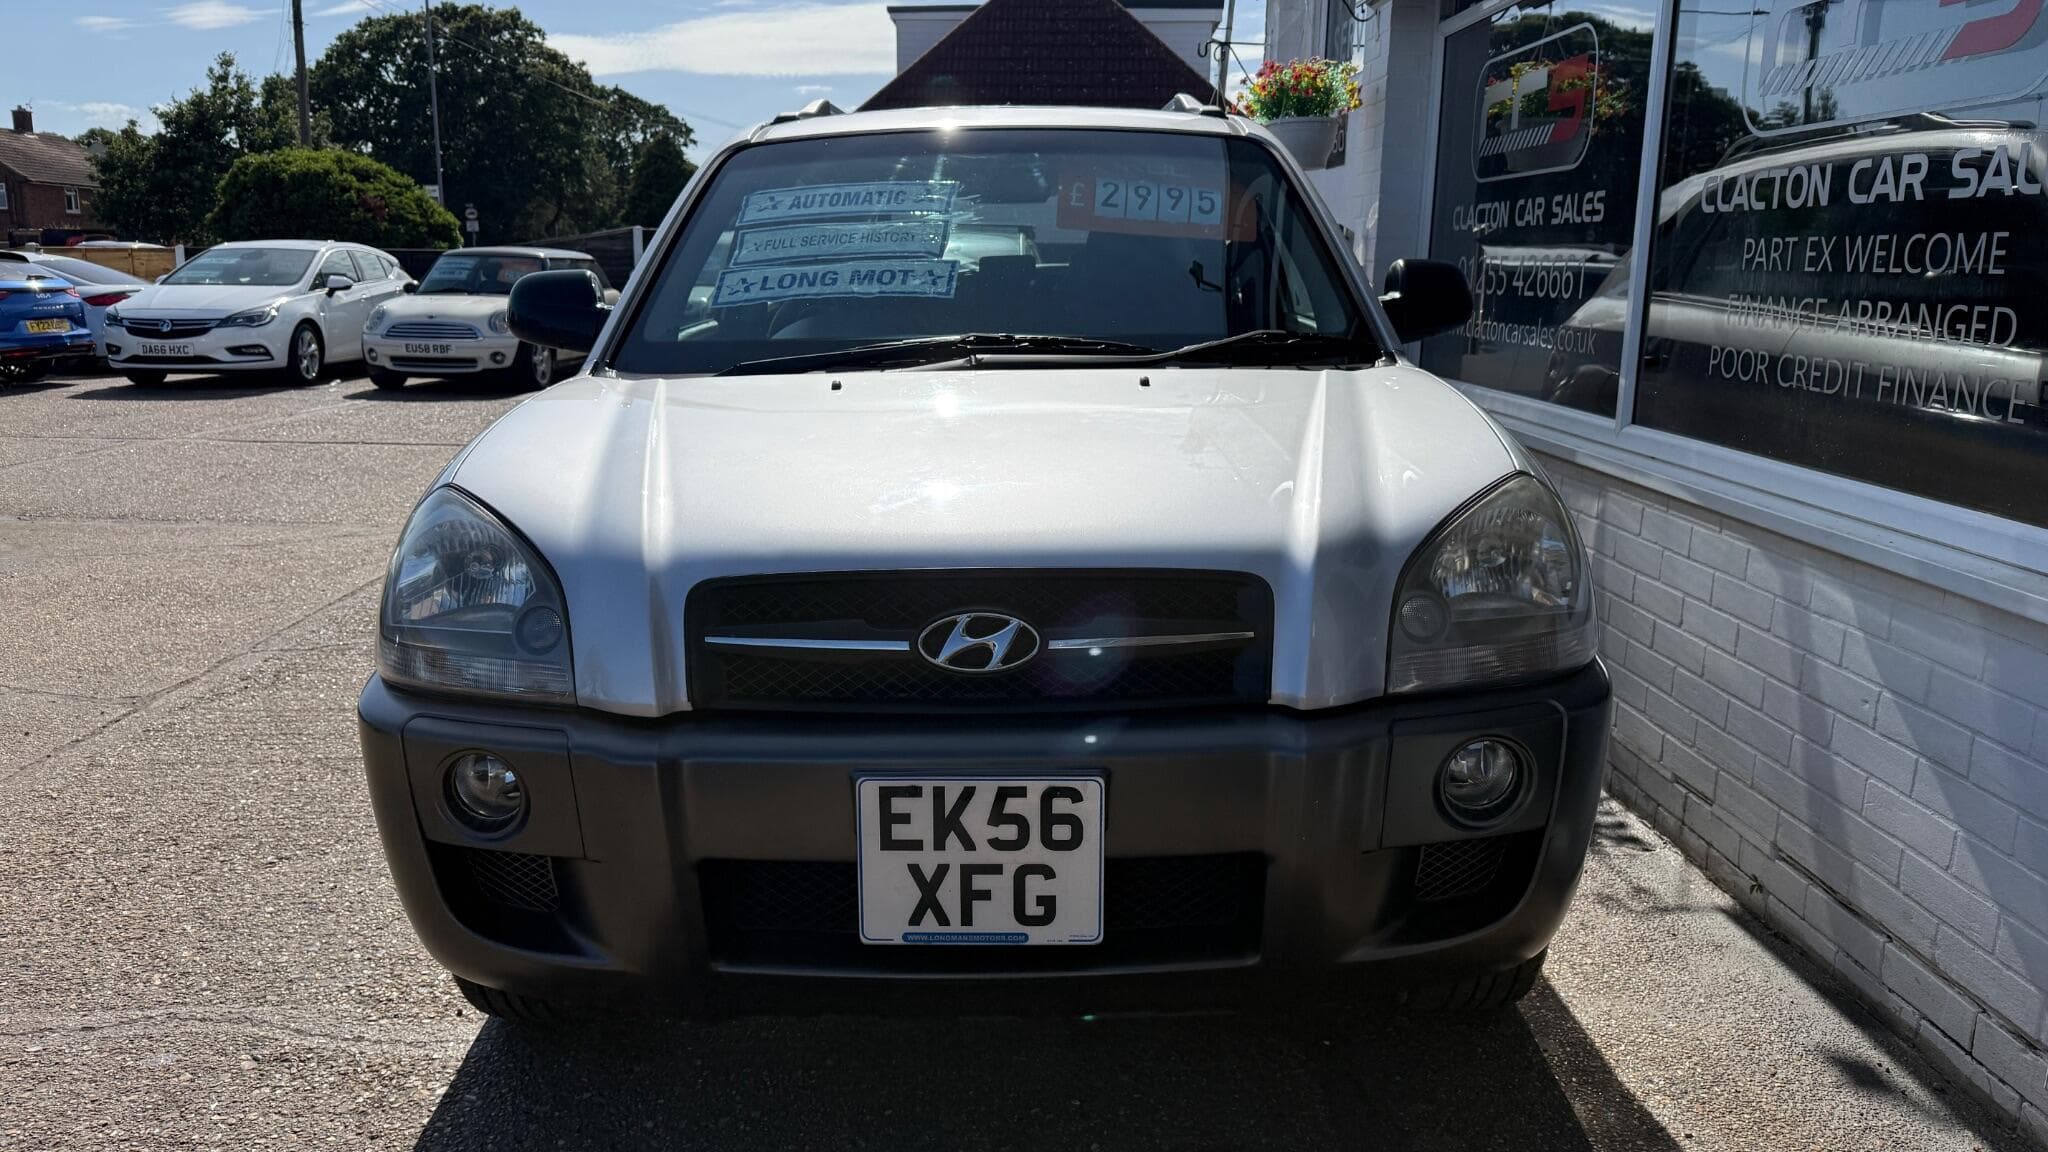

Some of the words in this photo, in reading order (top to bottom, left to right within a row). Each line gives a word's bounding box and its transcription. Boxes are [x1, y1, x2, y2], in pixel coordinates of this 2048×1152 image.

[787, 189, 907, 211] AUTOMATIC
[1700, 162, 1833, 214] CLACTON
[1849, 152, 1929, 204] CAR
[1452, 200, 1510, 233] CLACTON
[1514, 196, 1546, 228] CAR
[1551, 189, 1607, 225] SALES
[763, 237, 798, 252] FULL
[800, 232, 859, 248] SERVICE
[860, 231, 917, 245] HISTORY
[1741, 236, 1799, 272] PART
[1803, 235, 1837, 273] EX
[1845, 231, 2011, 275] WELCOME
[759, 269, 840, 292] LONG
[849, 268, 913, 287] MOT
[1512, 253, 1588, 300] 426661
[1725, 293, 1829, 334] FINANCE
[1832, 298, 2018, 349] ARRANGED
[142, 344, 167, 355] DA66
[168, 344, 190, 355] HXC
[405, 343, 431, 354] EU58
[1707, 345, 1769, 384] POOR
[1776, 353, 1870, 400] CREDIT
[1876, 365, 2036, 425] FINANCE
[878, 785, 1085, 852] EK56
[906, 863, 1058, 927] XFG
